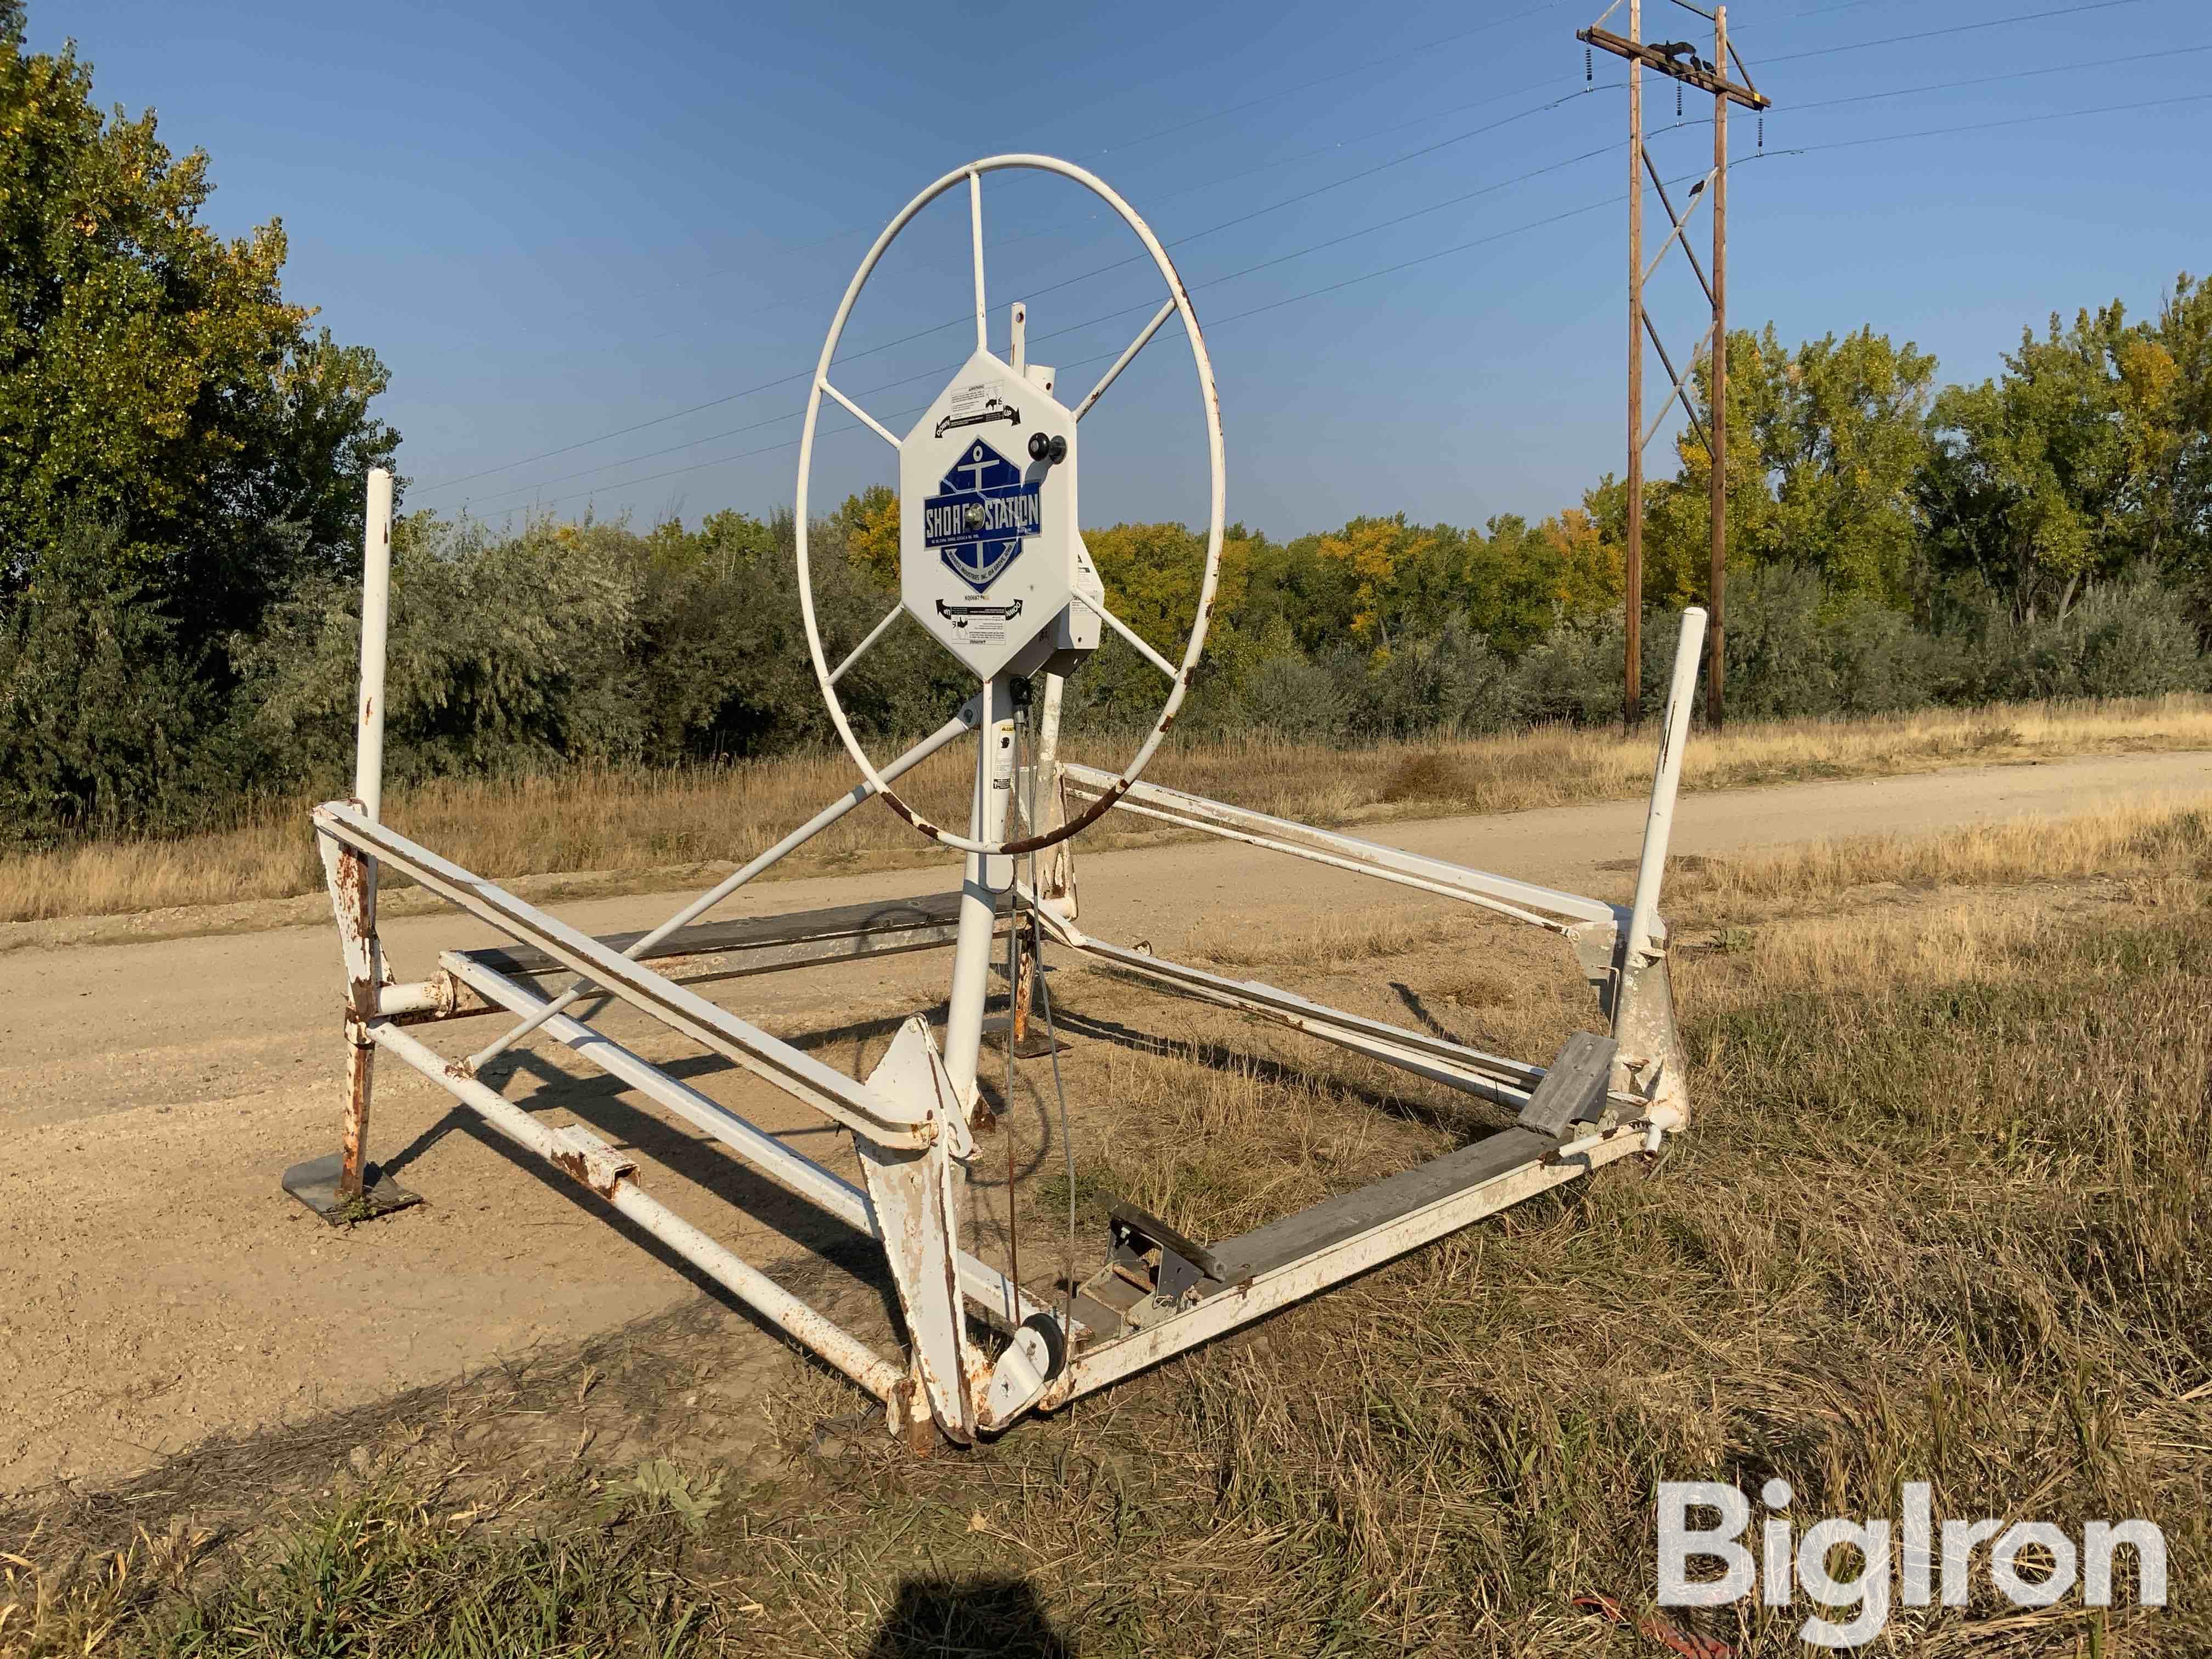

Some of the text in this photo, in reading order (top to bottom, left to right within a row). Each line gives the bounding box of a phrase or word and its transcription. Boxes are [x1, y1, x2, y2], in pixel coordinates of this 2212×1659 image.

[936, 419, 950, 436] DOWN
[985, 494, 1039, 530] STATION
[1006, 602, 1020, 617] DOWN
